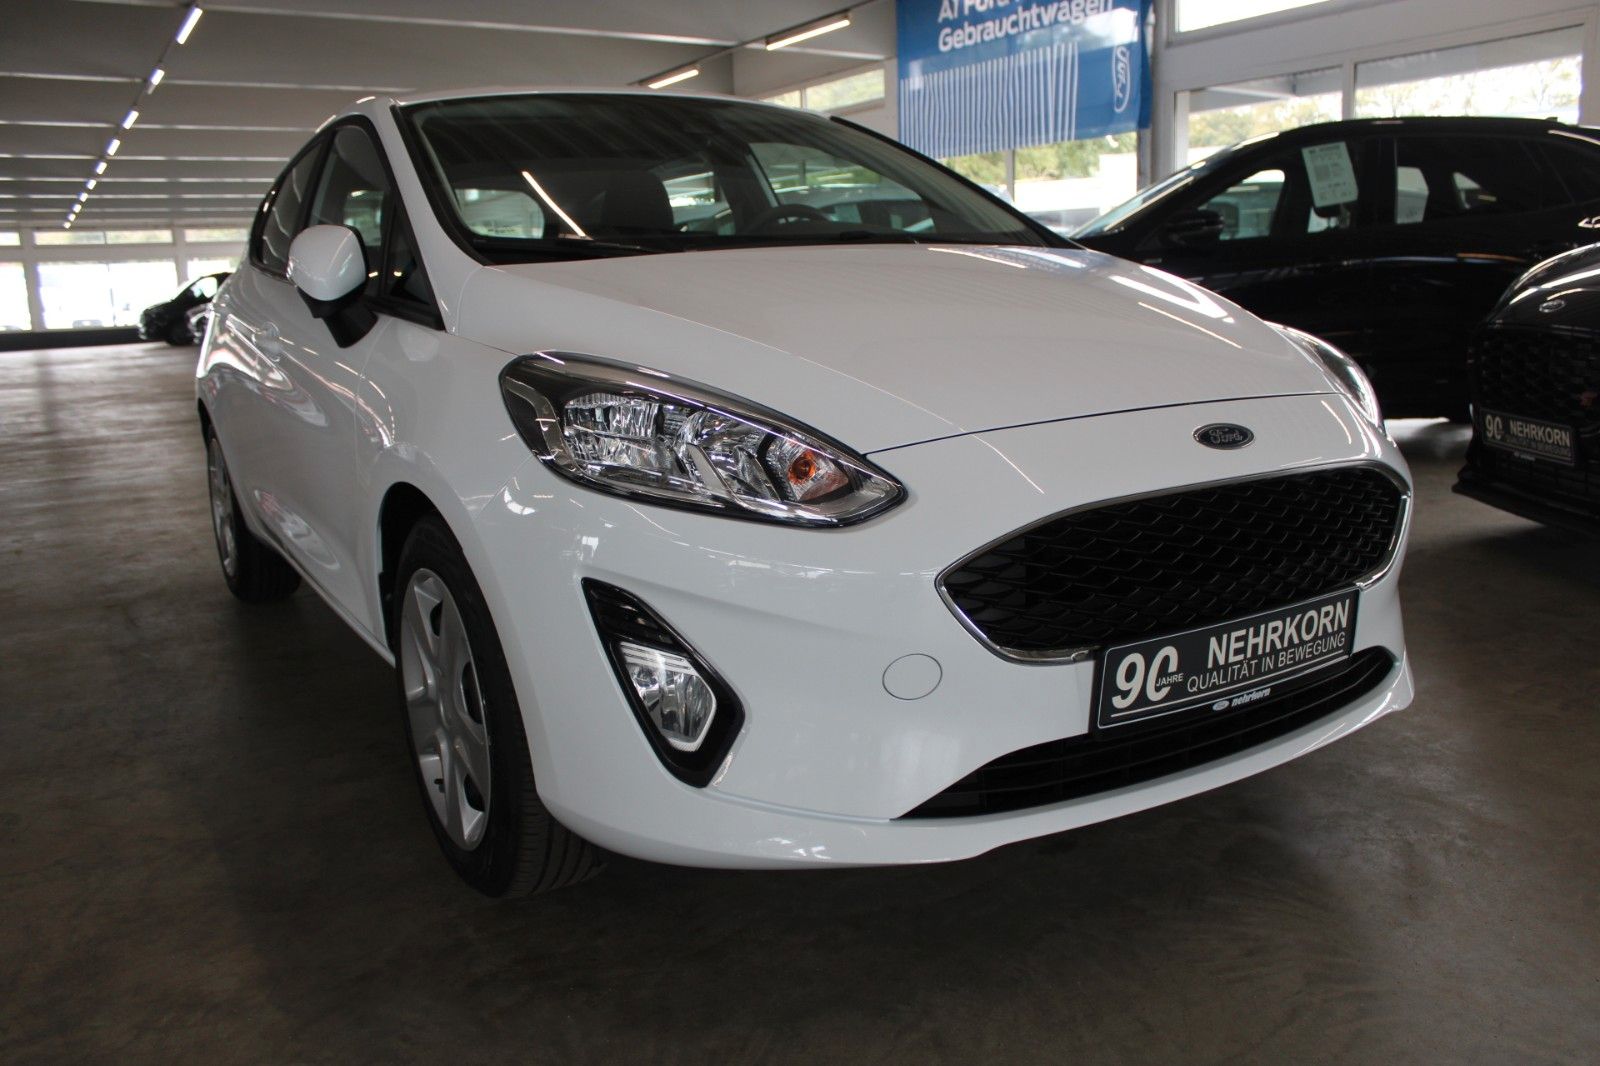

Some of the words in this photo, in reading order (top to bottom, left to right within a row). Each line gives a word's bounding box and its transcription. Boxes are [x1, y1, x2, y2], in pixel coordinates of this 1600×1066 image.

[937, 0, 1113, 51] Gebrauchtwagen
[1485, 414, 1502, 440] 90
[1509, 419, 1571, 447] NEHRKORN
[1187, 659, 1258, 692] QUALITÄT
[1261, 656, 1274, 673] IN
[1278, 631, 1346, 667] BEWEGUNG
[1207, 599, 1350, 669] NEHRKORN
[1111, 645, 1179, 709] 90
[1156, 672, 1184, 687] JAHRE
